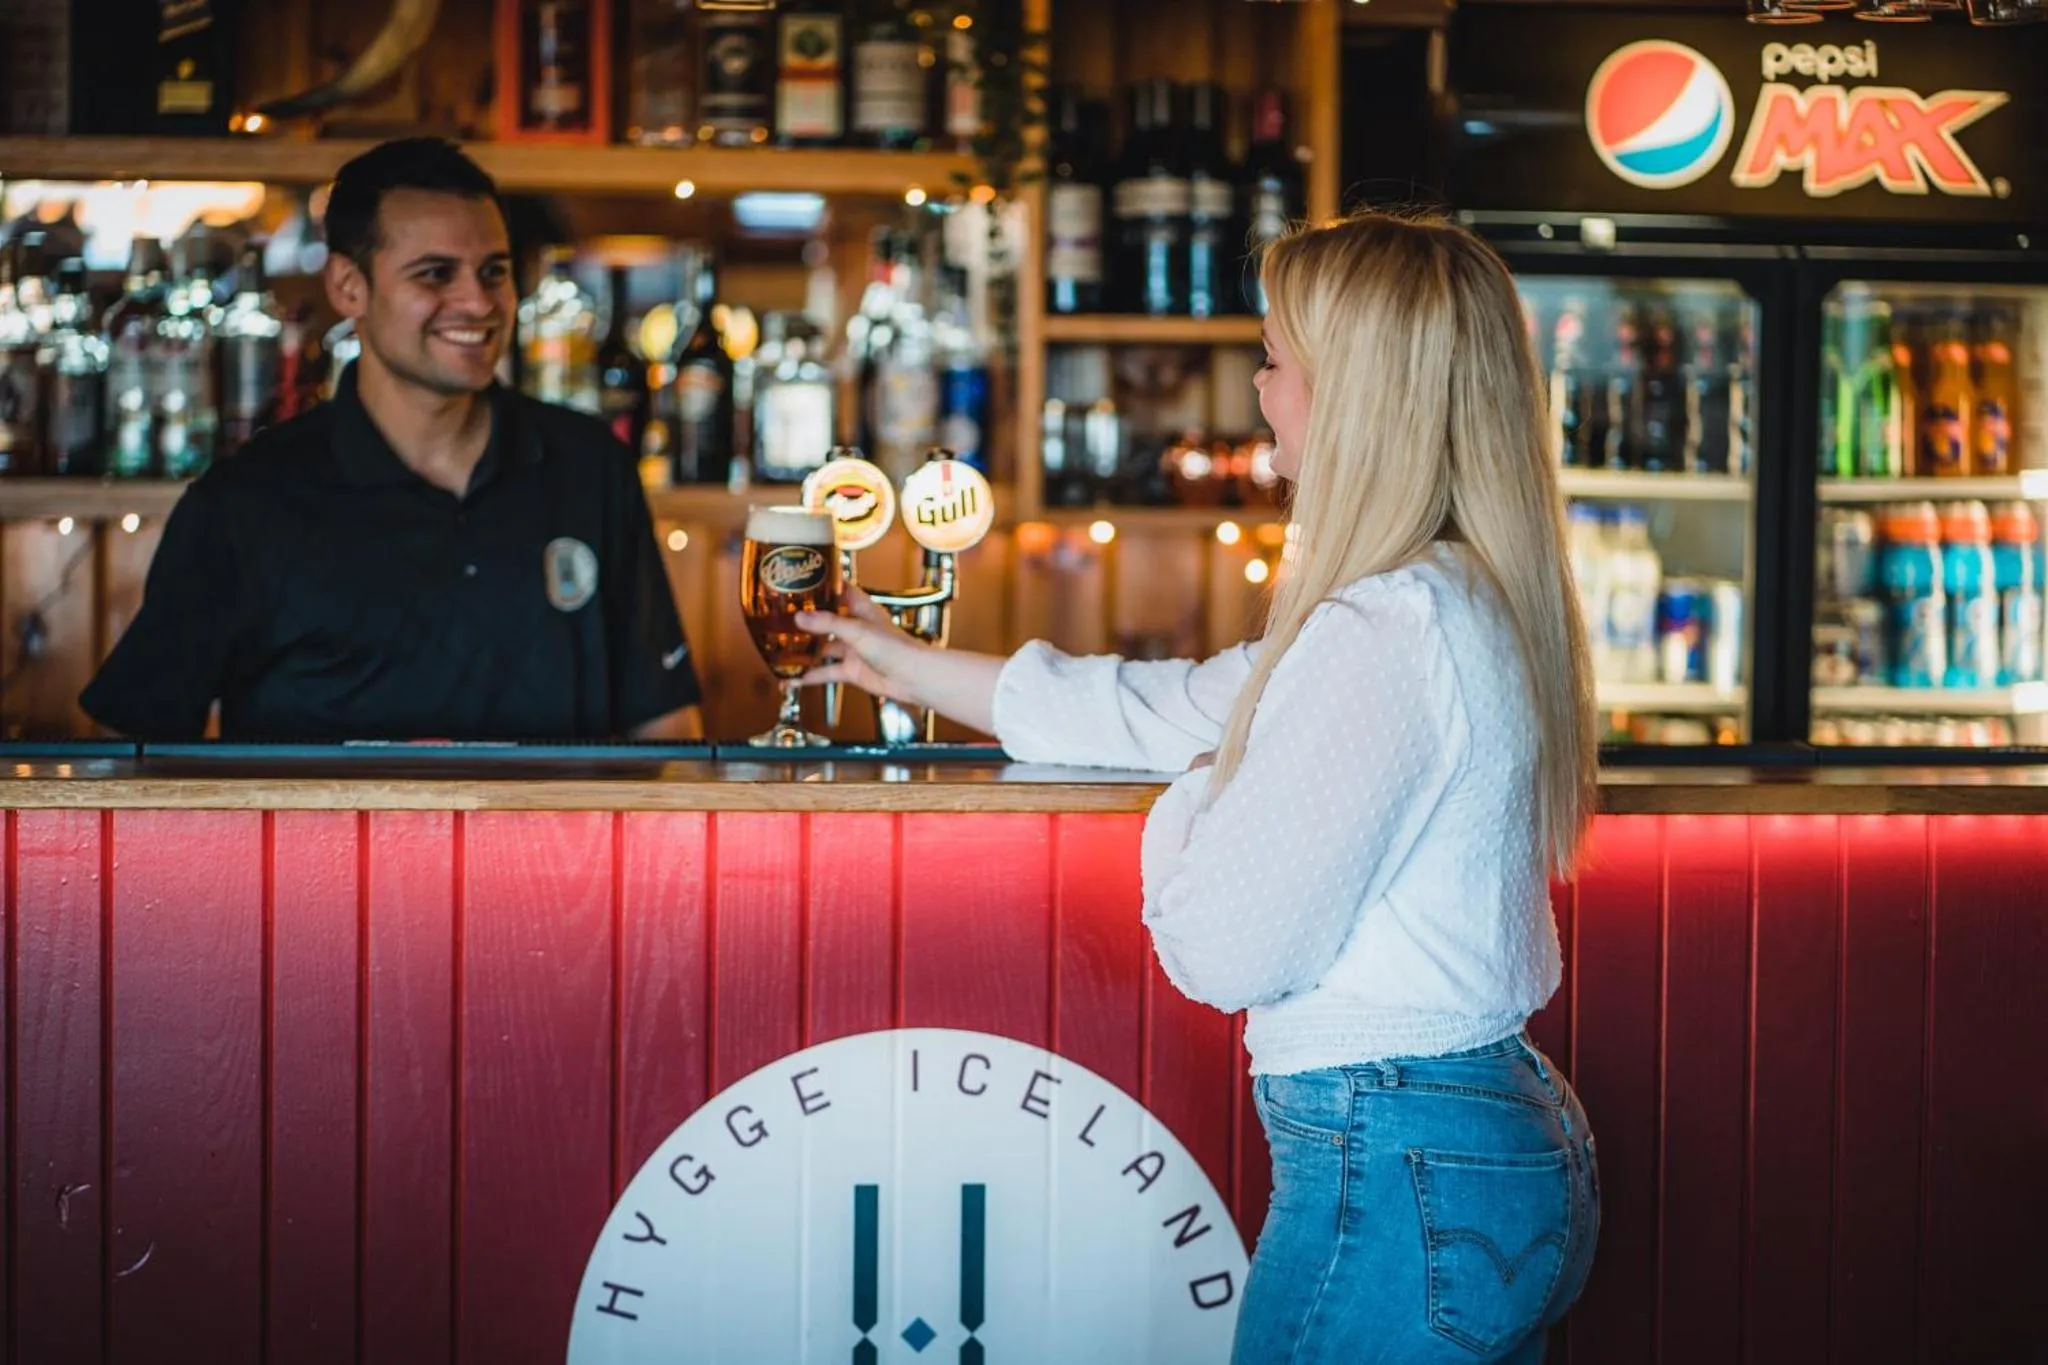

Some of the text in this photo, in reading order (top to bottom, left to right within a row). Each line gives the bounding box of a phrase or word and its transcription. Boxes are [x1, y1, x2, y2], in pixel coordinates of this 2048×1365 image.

[1761, 39, 1879, 82] pepsi
[917, 486, 977, 527] Gull
[596, 1048, 1234, 1322] HYGGE ICELAND
